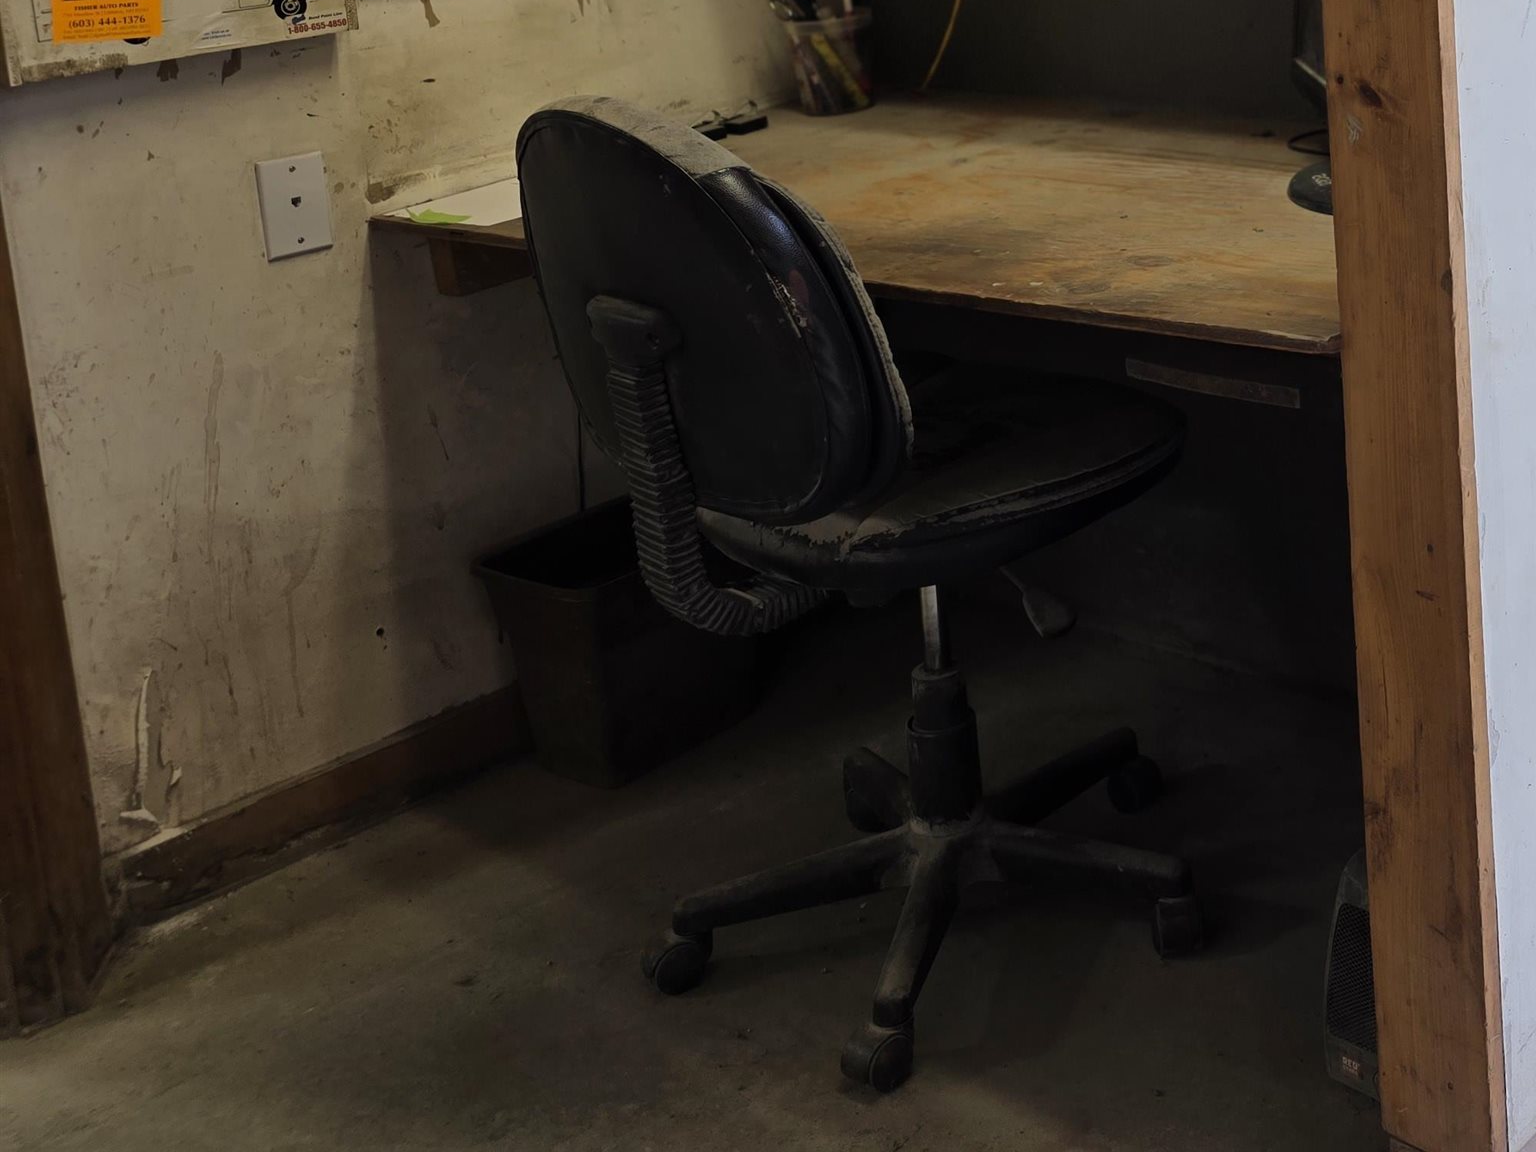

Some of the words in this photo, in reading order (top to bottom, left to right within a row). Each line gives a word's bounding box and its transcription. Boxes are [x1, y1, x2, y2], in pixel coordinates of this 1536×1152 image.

[68, 19, 95, 29] (603)
[98, 15, 146, 26] 444-1376
[288, 18, 347, 34] 1-800-655-4850
